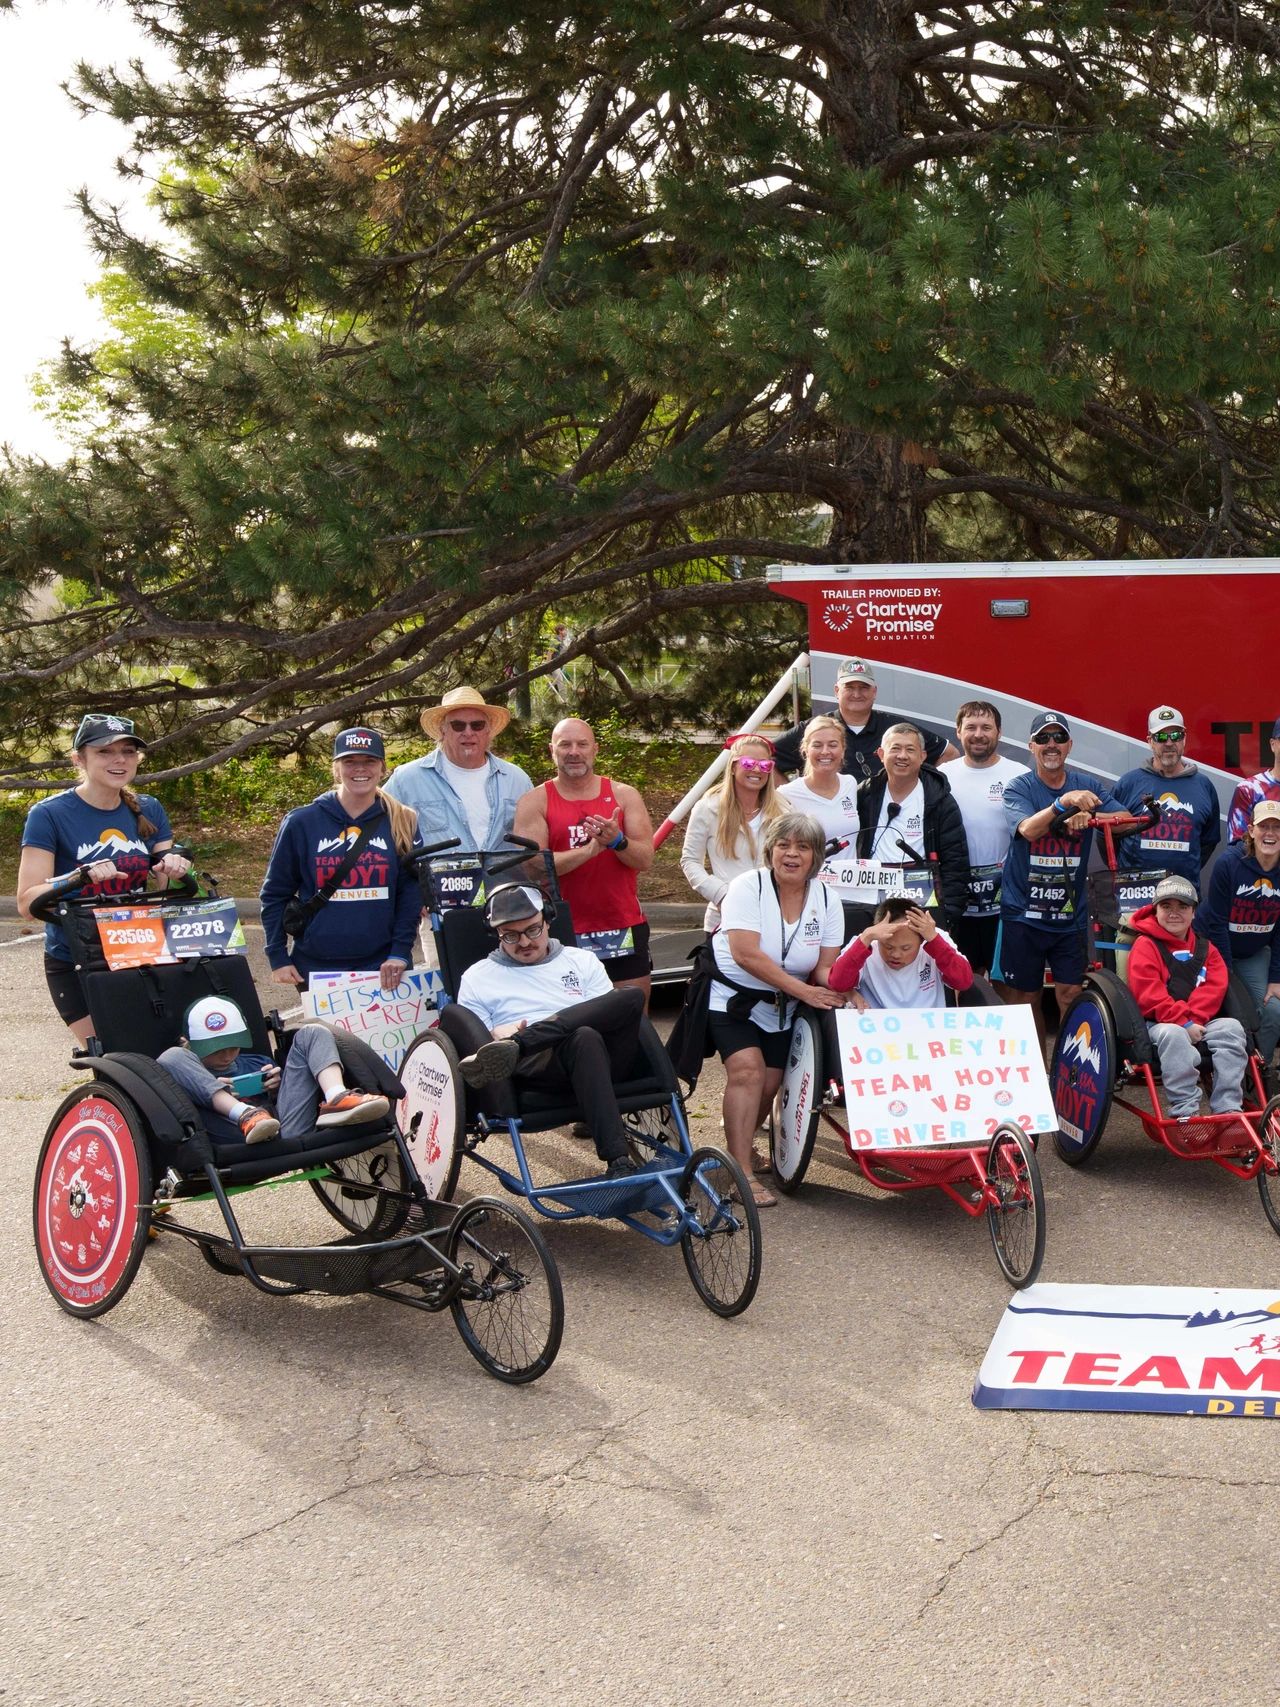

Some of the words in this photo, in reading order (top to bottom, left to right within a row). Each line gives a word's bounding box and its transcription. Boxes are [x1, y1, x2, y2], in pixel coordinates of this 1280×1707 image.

[822, 590, 866, 599] TRAILER
[869, 589, 920, 598] PROVIDED
[924, 588, 941, 597] BY:
[856, 602, 942, 620] Chartway
[866, 617, 934, 632] Promise
[346, 736, 372, 746] HOYT
[1148, 841, 1183, 849] DENVER
[316, 864, 390, 888] HOYT
[441, 876, 473, 892] 20895
[842, 870, 853, 883] GO
[857, 871, 876, 886] JOEL
[878, 872, 897, 885] REY!
[332, 890, 378, 899] DENVER
[968, 880, 994, 893] 1375
[1030, 886, 1066, 900] 21452
[1120, 886, 1155, 900] 20633
[107, 928, 156, 945] 23566
[170, 920, 226, 939] 22378
[313, 985, 374, 1017] LETS
[858, 1016, 901, 1034] GO
[921, 1012, 1004, 1030] TEAM
[849, 1042, 920, 1065] JOEL
[928, 1038, 984, 1058] REY
[418, 1062, 449, 1088] Chartway
[851, 1073, 933, 1097] TEAM
[955, 1066, 1030, 1087] HOYT
[417, 1077, 443, 1099] Promise
[931, 1093, 972, 1113] VB
[1056, 1079, 1097, 1131] HOYT
[854, 1121, 967, 1147] DENVER
